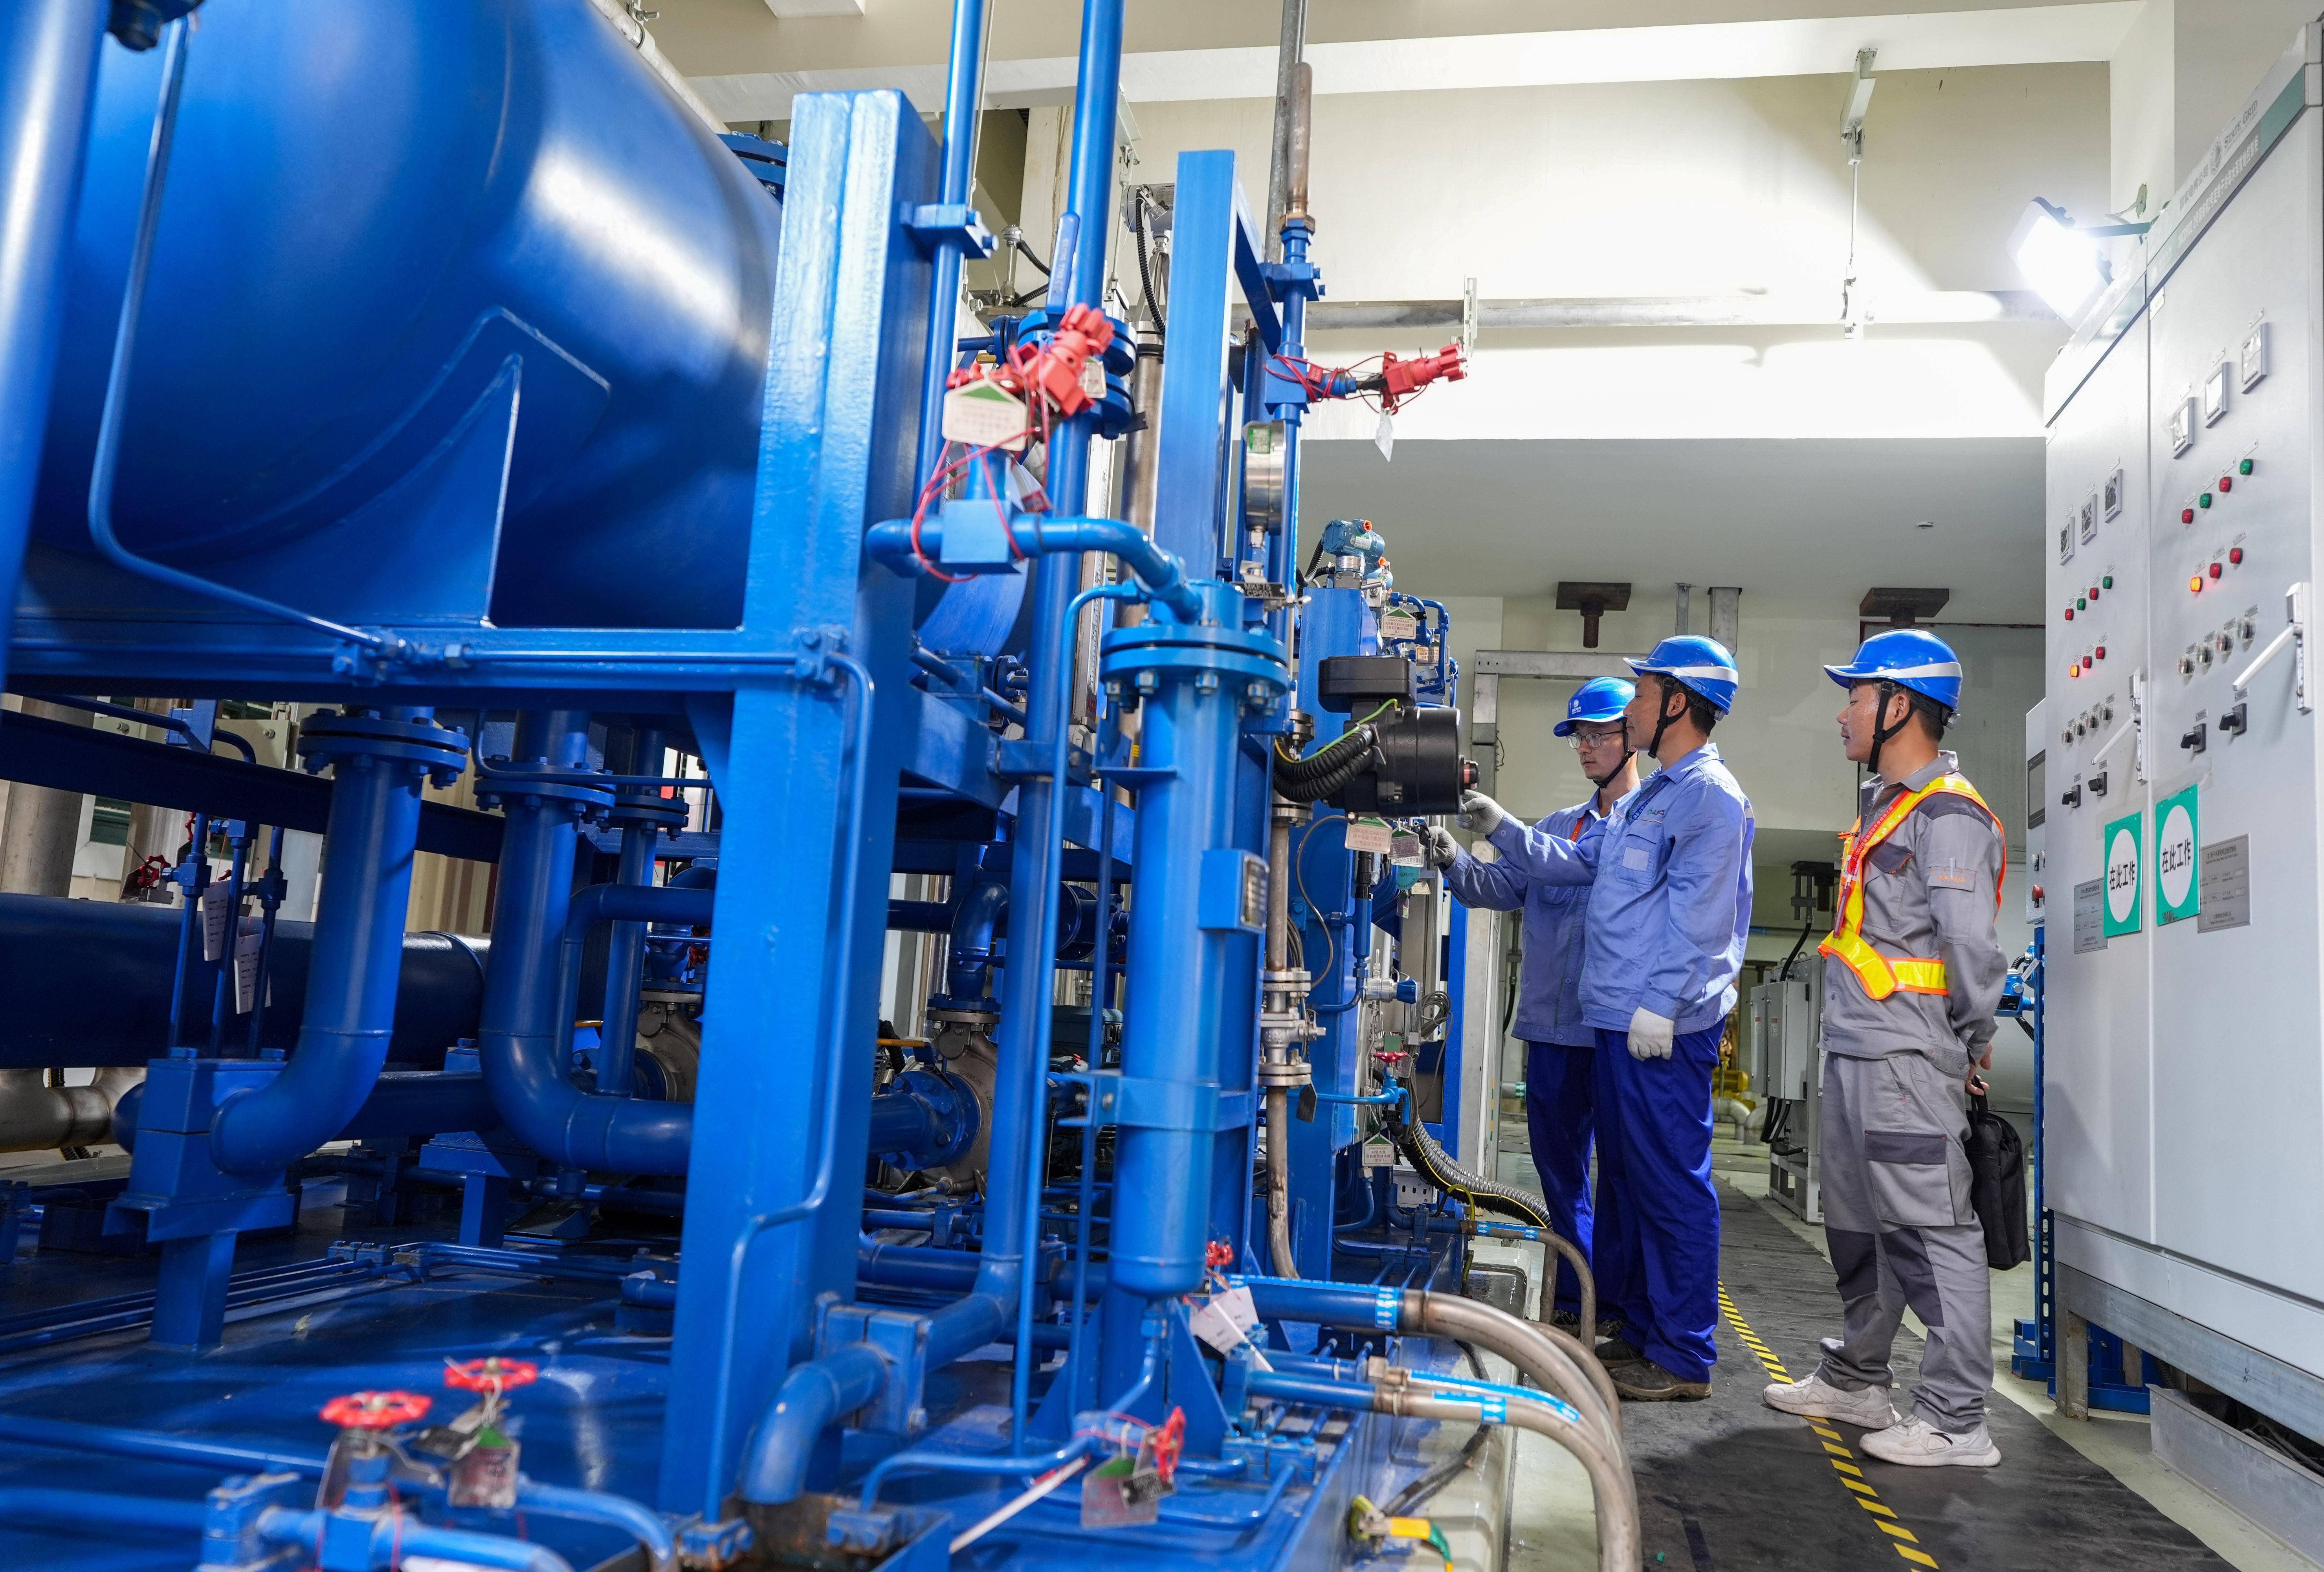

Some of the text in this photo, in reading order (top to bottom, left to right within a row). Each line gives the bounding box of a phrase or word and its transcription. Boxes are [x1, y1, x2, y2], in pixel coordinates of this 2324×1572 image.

[2224, 121, 2241, 149] STATE
[2243, 100, 2258, 124] GRID
[2179, 164, 2208, 211] 国家电网公司
[2110, 860, 2135, 892] 在此工作
[2162, 838, 2191, 875] 在此工作
